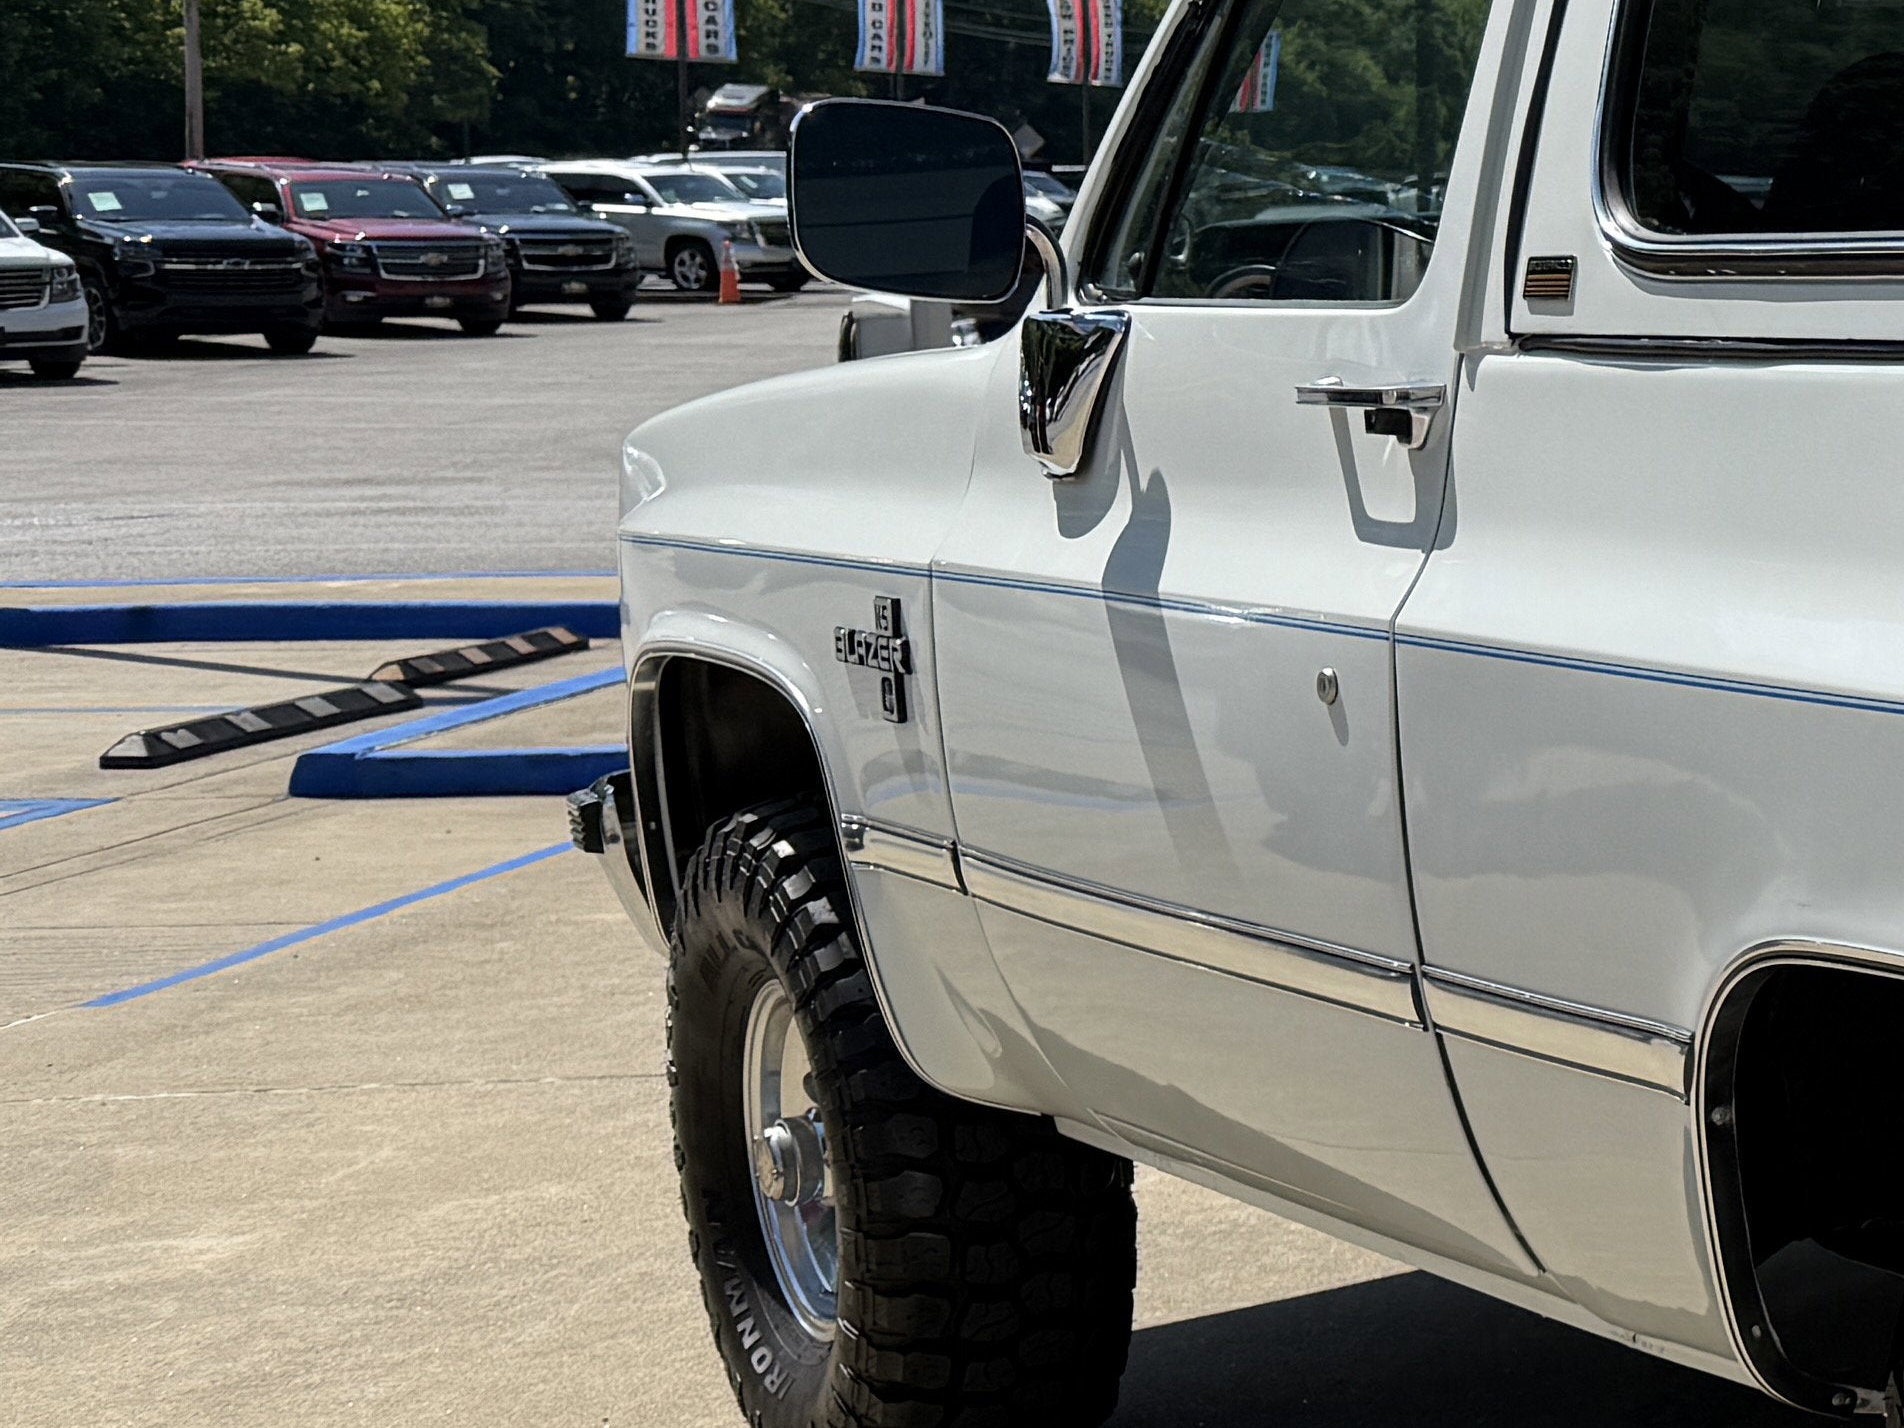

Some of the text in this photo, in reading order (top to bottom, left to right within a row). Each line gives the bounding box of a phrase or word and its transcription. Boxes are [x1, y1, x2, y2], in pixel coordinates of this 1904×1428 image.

[704, 0, 720, 55] CARS
[870, 19, 883, 65] CARS
[834, 626, 906, 674] BLAZER
